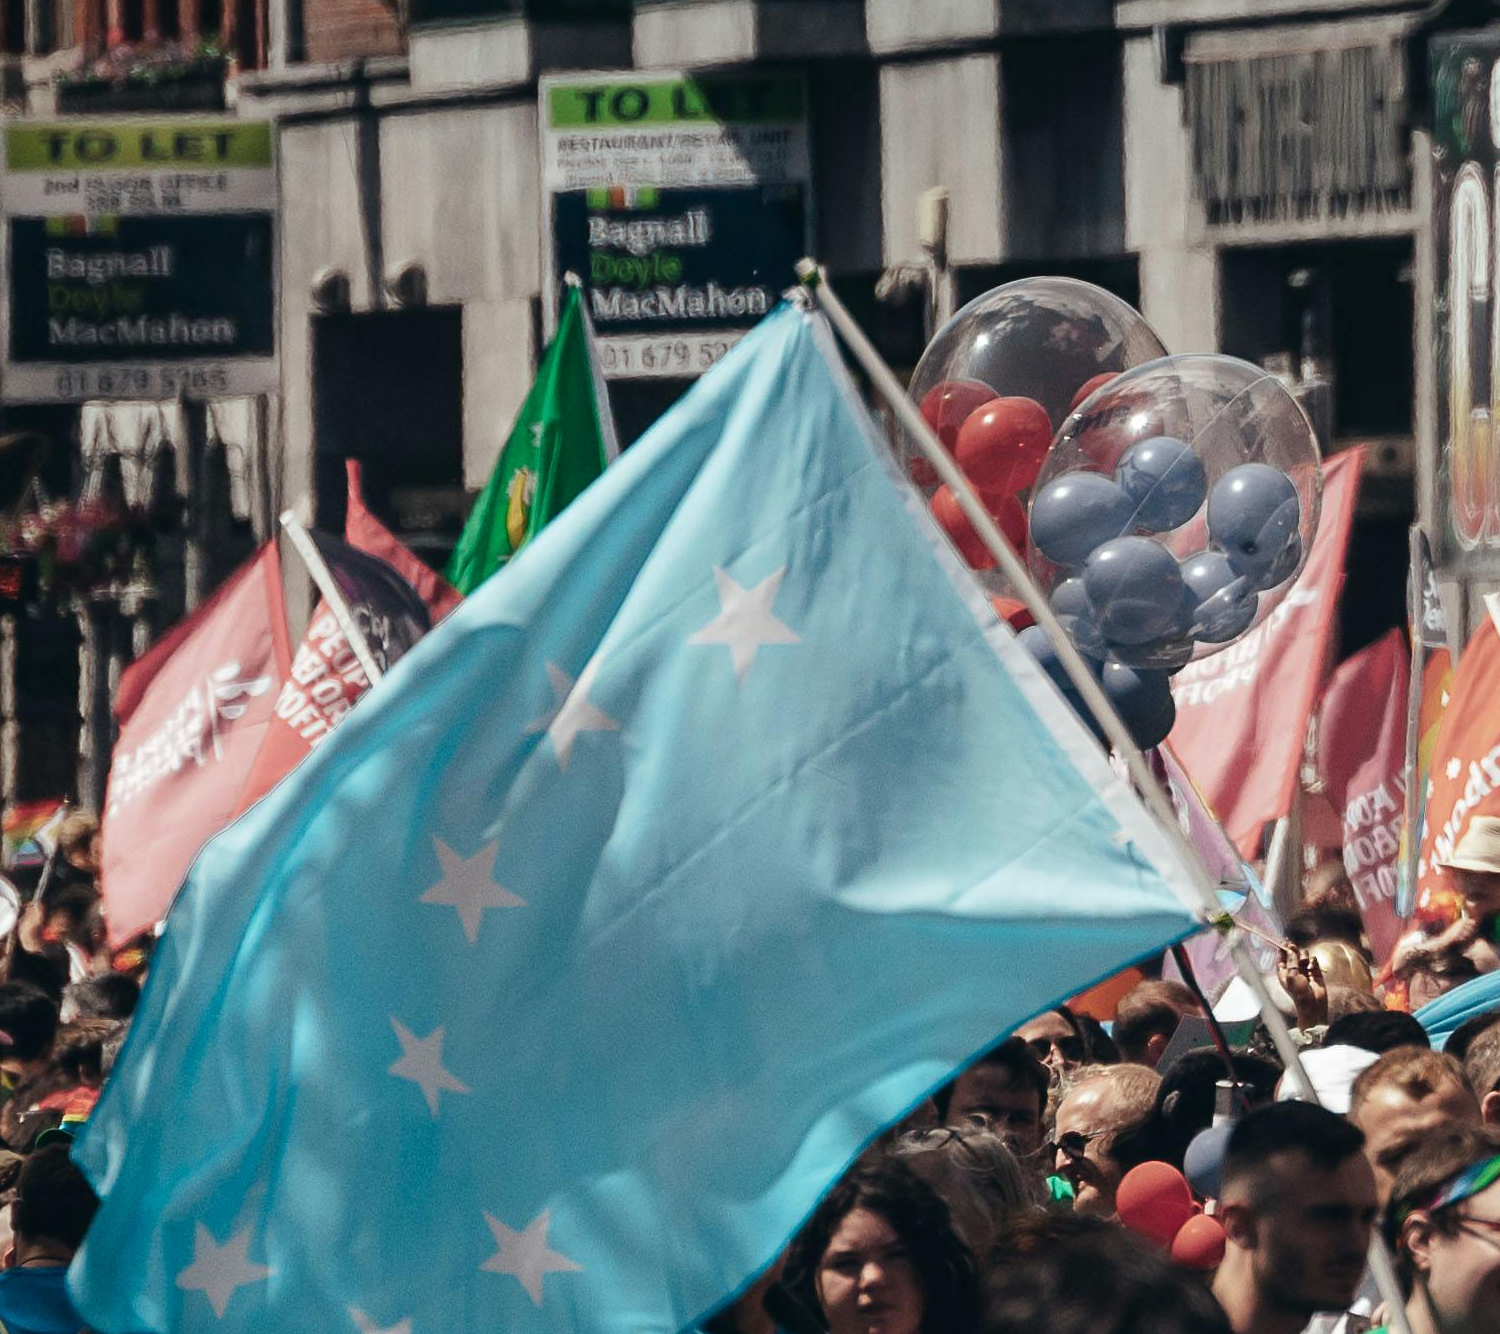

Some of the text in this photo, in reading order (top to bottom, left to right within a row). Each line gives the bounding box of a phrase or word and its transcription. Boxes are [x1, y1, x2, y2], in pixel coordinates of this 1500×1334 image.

[577, 87, 649, 123] TO
[38, 129, 235, 165] TO LET
[587, 208, 713, 256] Bagnall
[45, 244, 174, 285] Bagnall
[590, 252, 684, 288] Doyle
[590, 283, 768, 323] MacMahon
[47, 313, 239, 347] MacMahon
